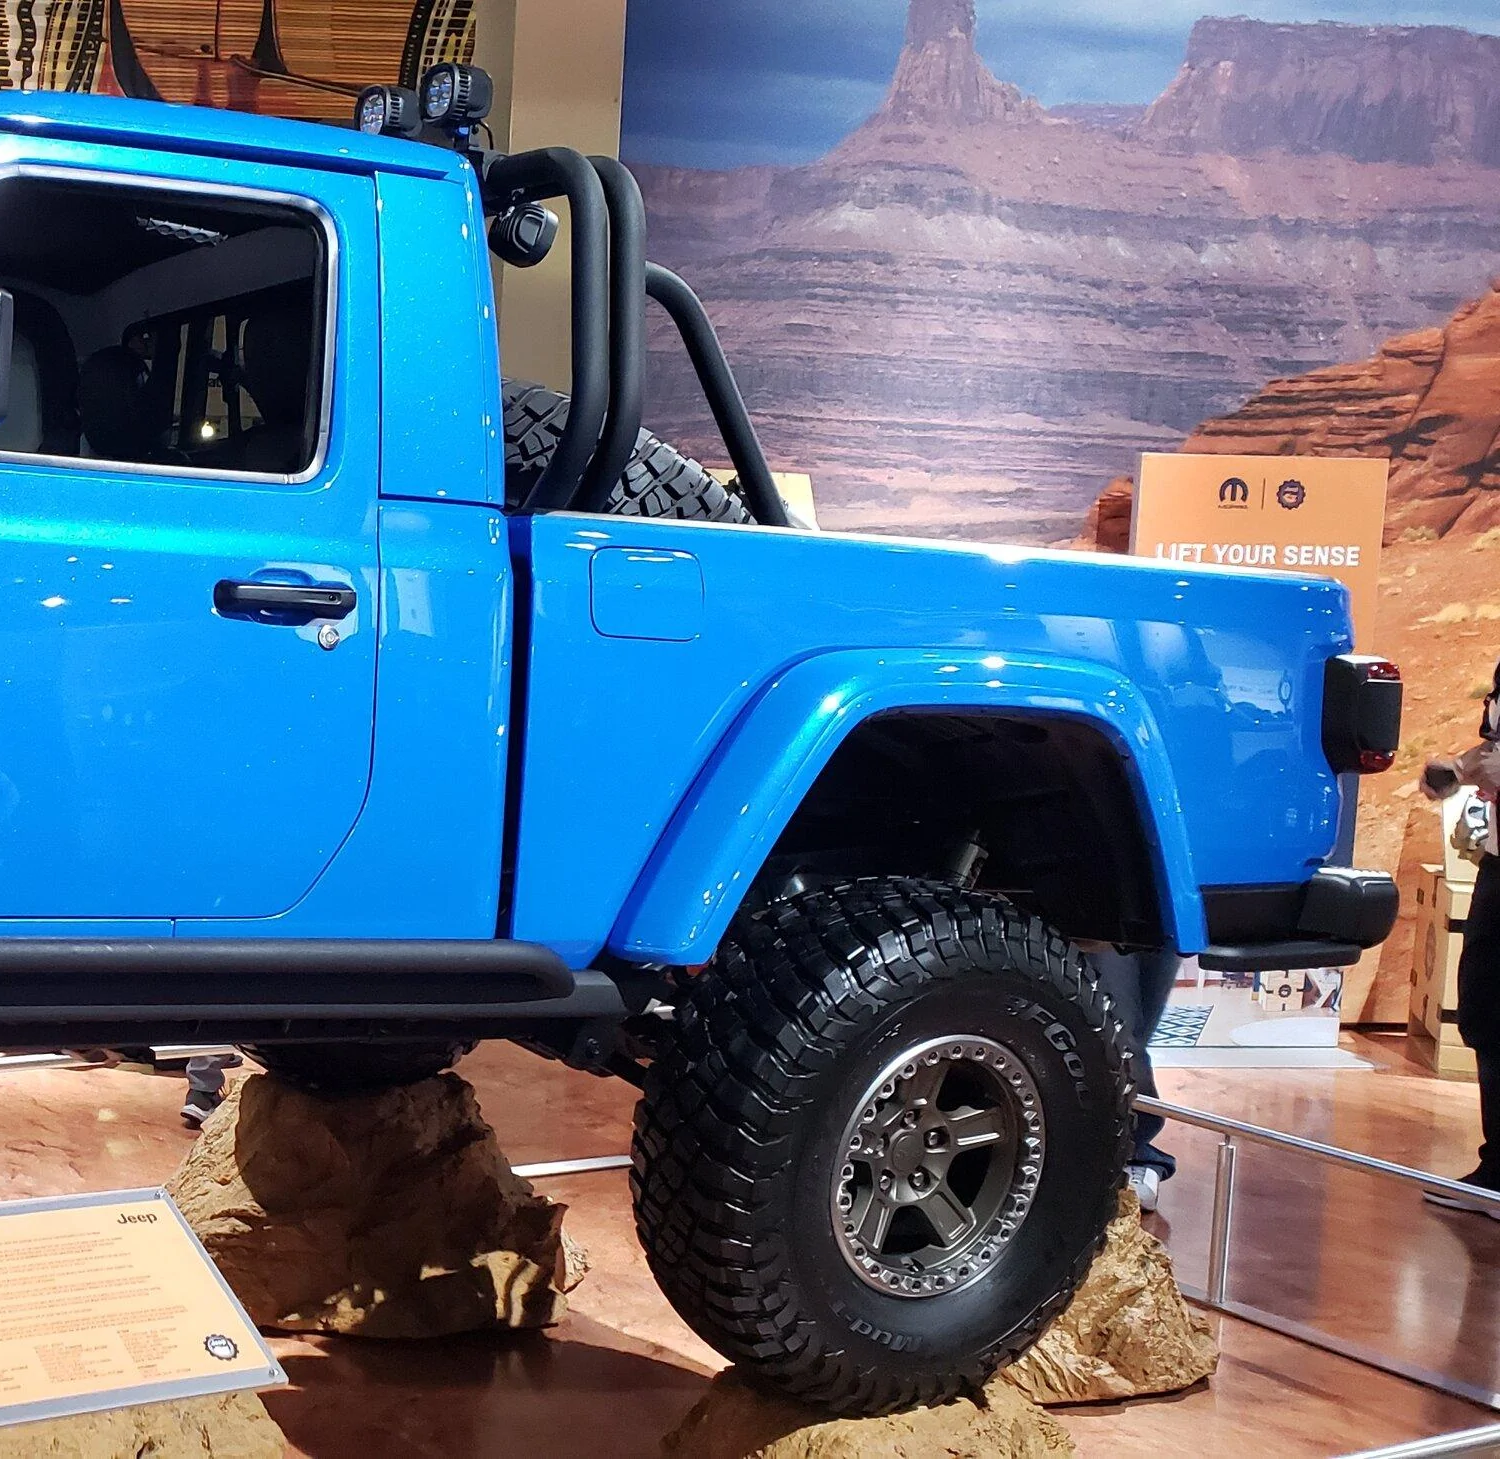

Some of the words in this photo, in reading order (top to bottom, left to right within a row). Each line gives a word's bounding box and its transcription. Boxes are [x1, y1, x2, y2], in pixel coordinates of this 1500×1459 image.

[1155, 542, 1207, 564] LIFT
[1213, 543, 1276, 565] YOUR
[1283, 545, 1361, 567] SENSE
[117, 1213, 158, 1225] Jeep
